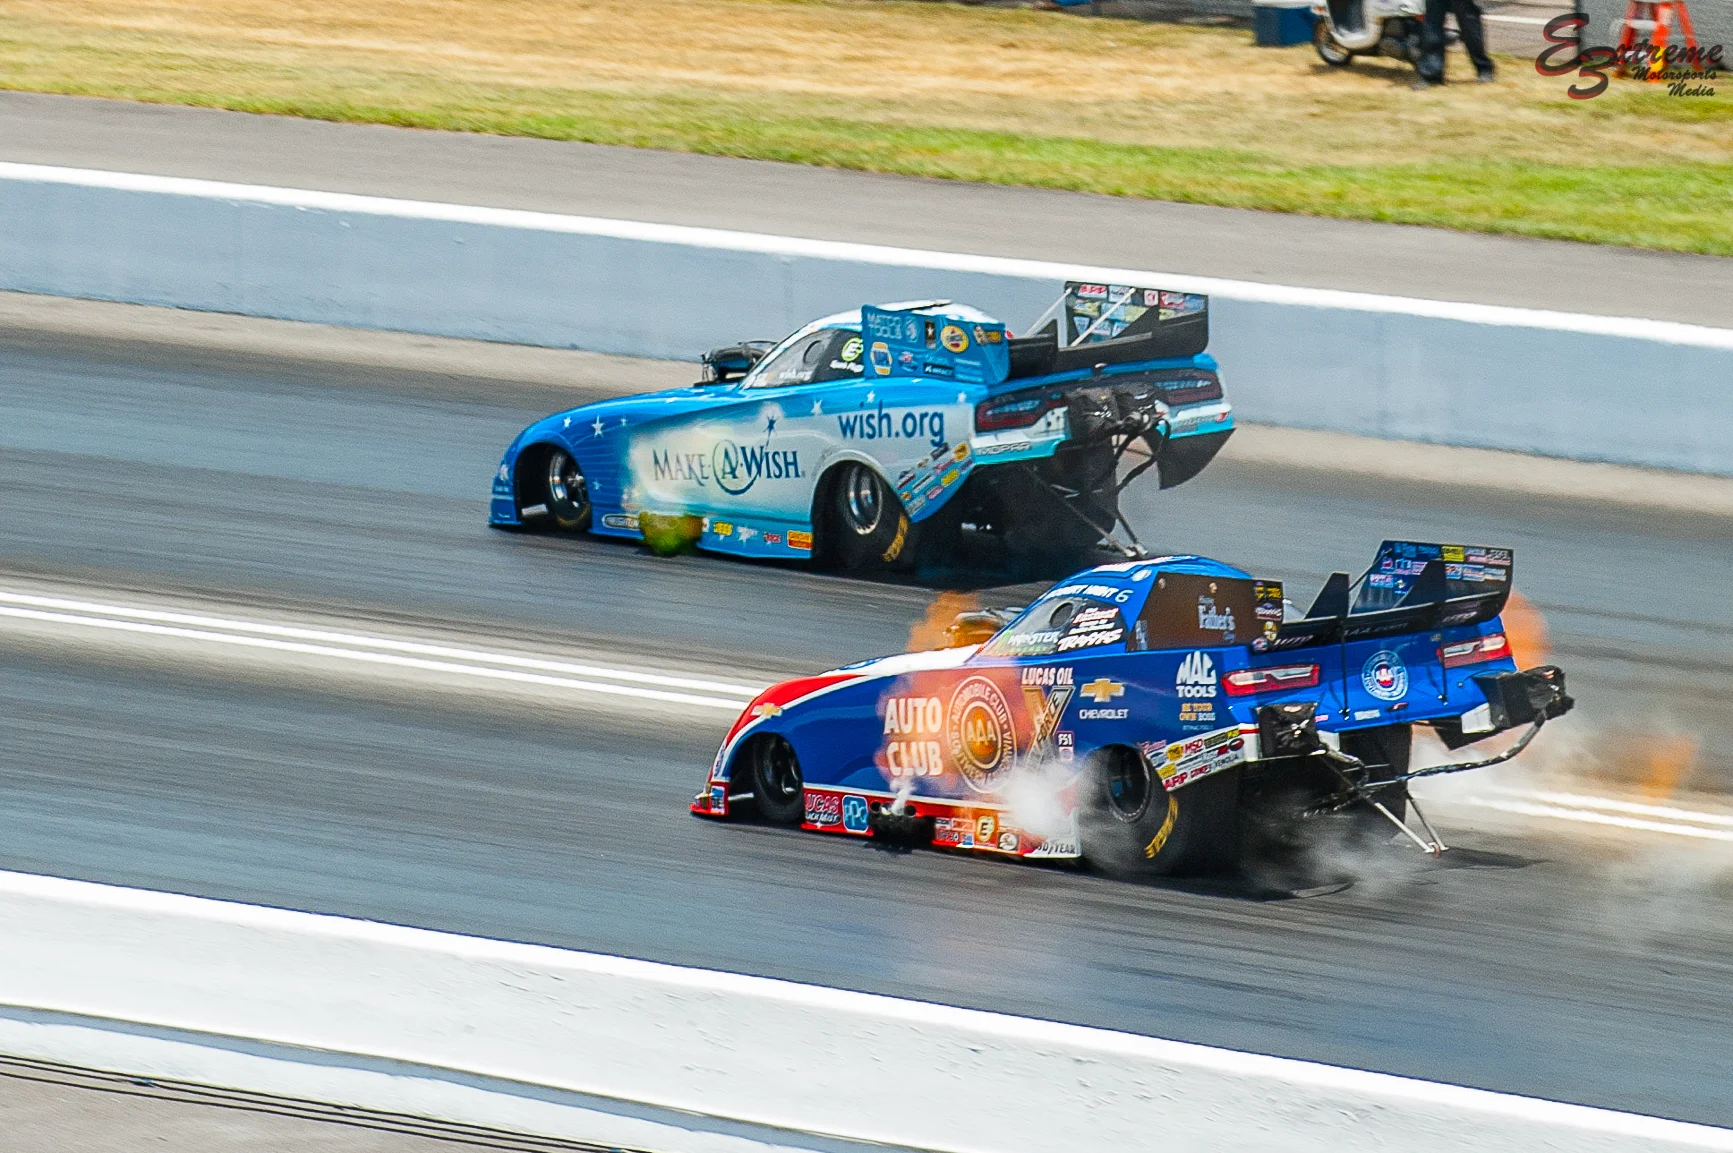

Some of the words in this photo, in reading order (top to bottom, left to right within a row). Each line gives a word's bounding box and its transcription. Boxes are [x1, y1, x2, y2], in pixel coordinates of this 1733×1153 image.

[838, 400, 944, 446] wish.org
[976, 441, 1032, 456] MOPAR
[1115, 590, 1133, 603] 6
[1021, 667, 1056, 686] LUCAS
[1056, 667, 1074, 685] OIL
[1176, 651, 1217, 685] MAC
[1177, 685, 1217, 698] TOOLS
[884, 697, 943, 735] AUTO
[1079, 708, 1130, 720] CHEVROLET
[966, 719, 997, 747] AAA
[887, 742, 944, 777] CLUB
[845, 800, 868, 828] PPG
